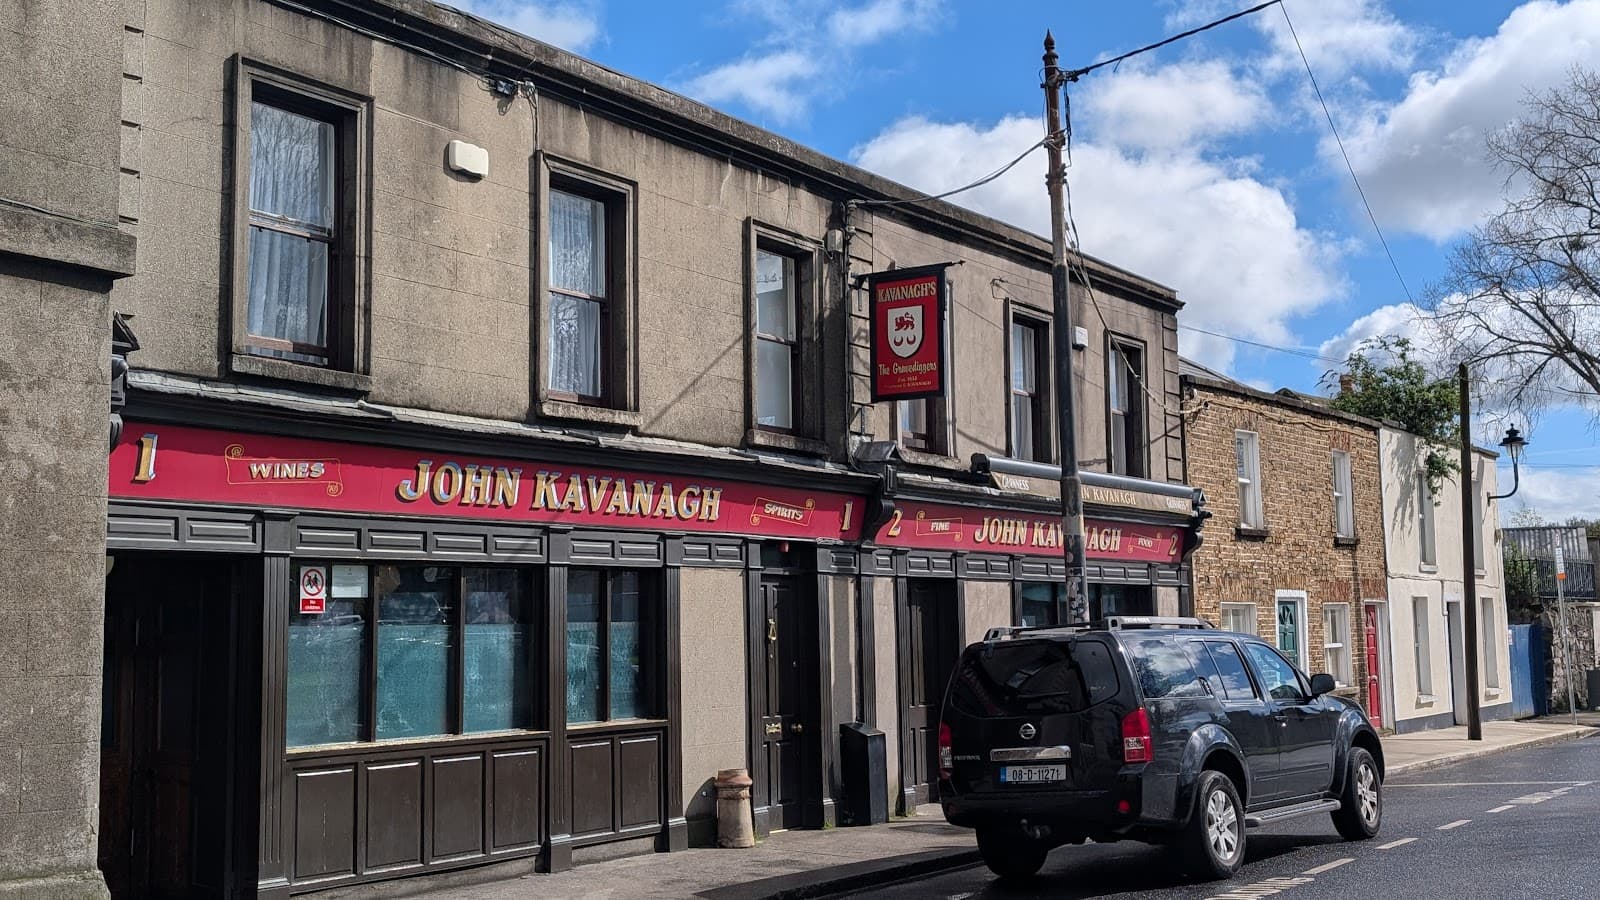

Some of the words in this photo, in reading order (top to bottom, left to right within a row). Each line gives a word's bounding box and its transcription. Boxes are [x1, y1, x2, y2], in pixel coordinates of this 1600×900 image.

[878, 281, 937, 302] KAVANAGH'S
[878, 363, 890, 376] The
[892, 360, 937, 375] Gravediggers
[133, 433, 159, 483] 1
[250, 462, 325, 479] WINES
[398, 460, 522, 508] JOHN
[530, 470, 723, 521] KAVANAGH
[1093, 489, 1137, 505] KAVANAGH
[763, 503, 804, 521] SPIRITS
[840, 501, 854, 532] 1
[887, 508, 903, 538] 2
[930, 521, 951, 532] FINE
[974, 516, 1029, 546] JOHN
[1168, 533, 1179, 556] 2
[1012, 768, 1060, 781] 08-D-11271
